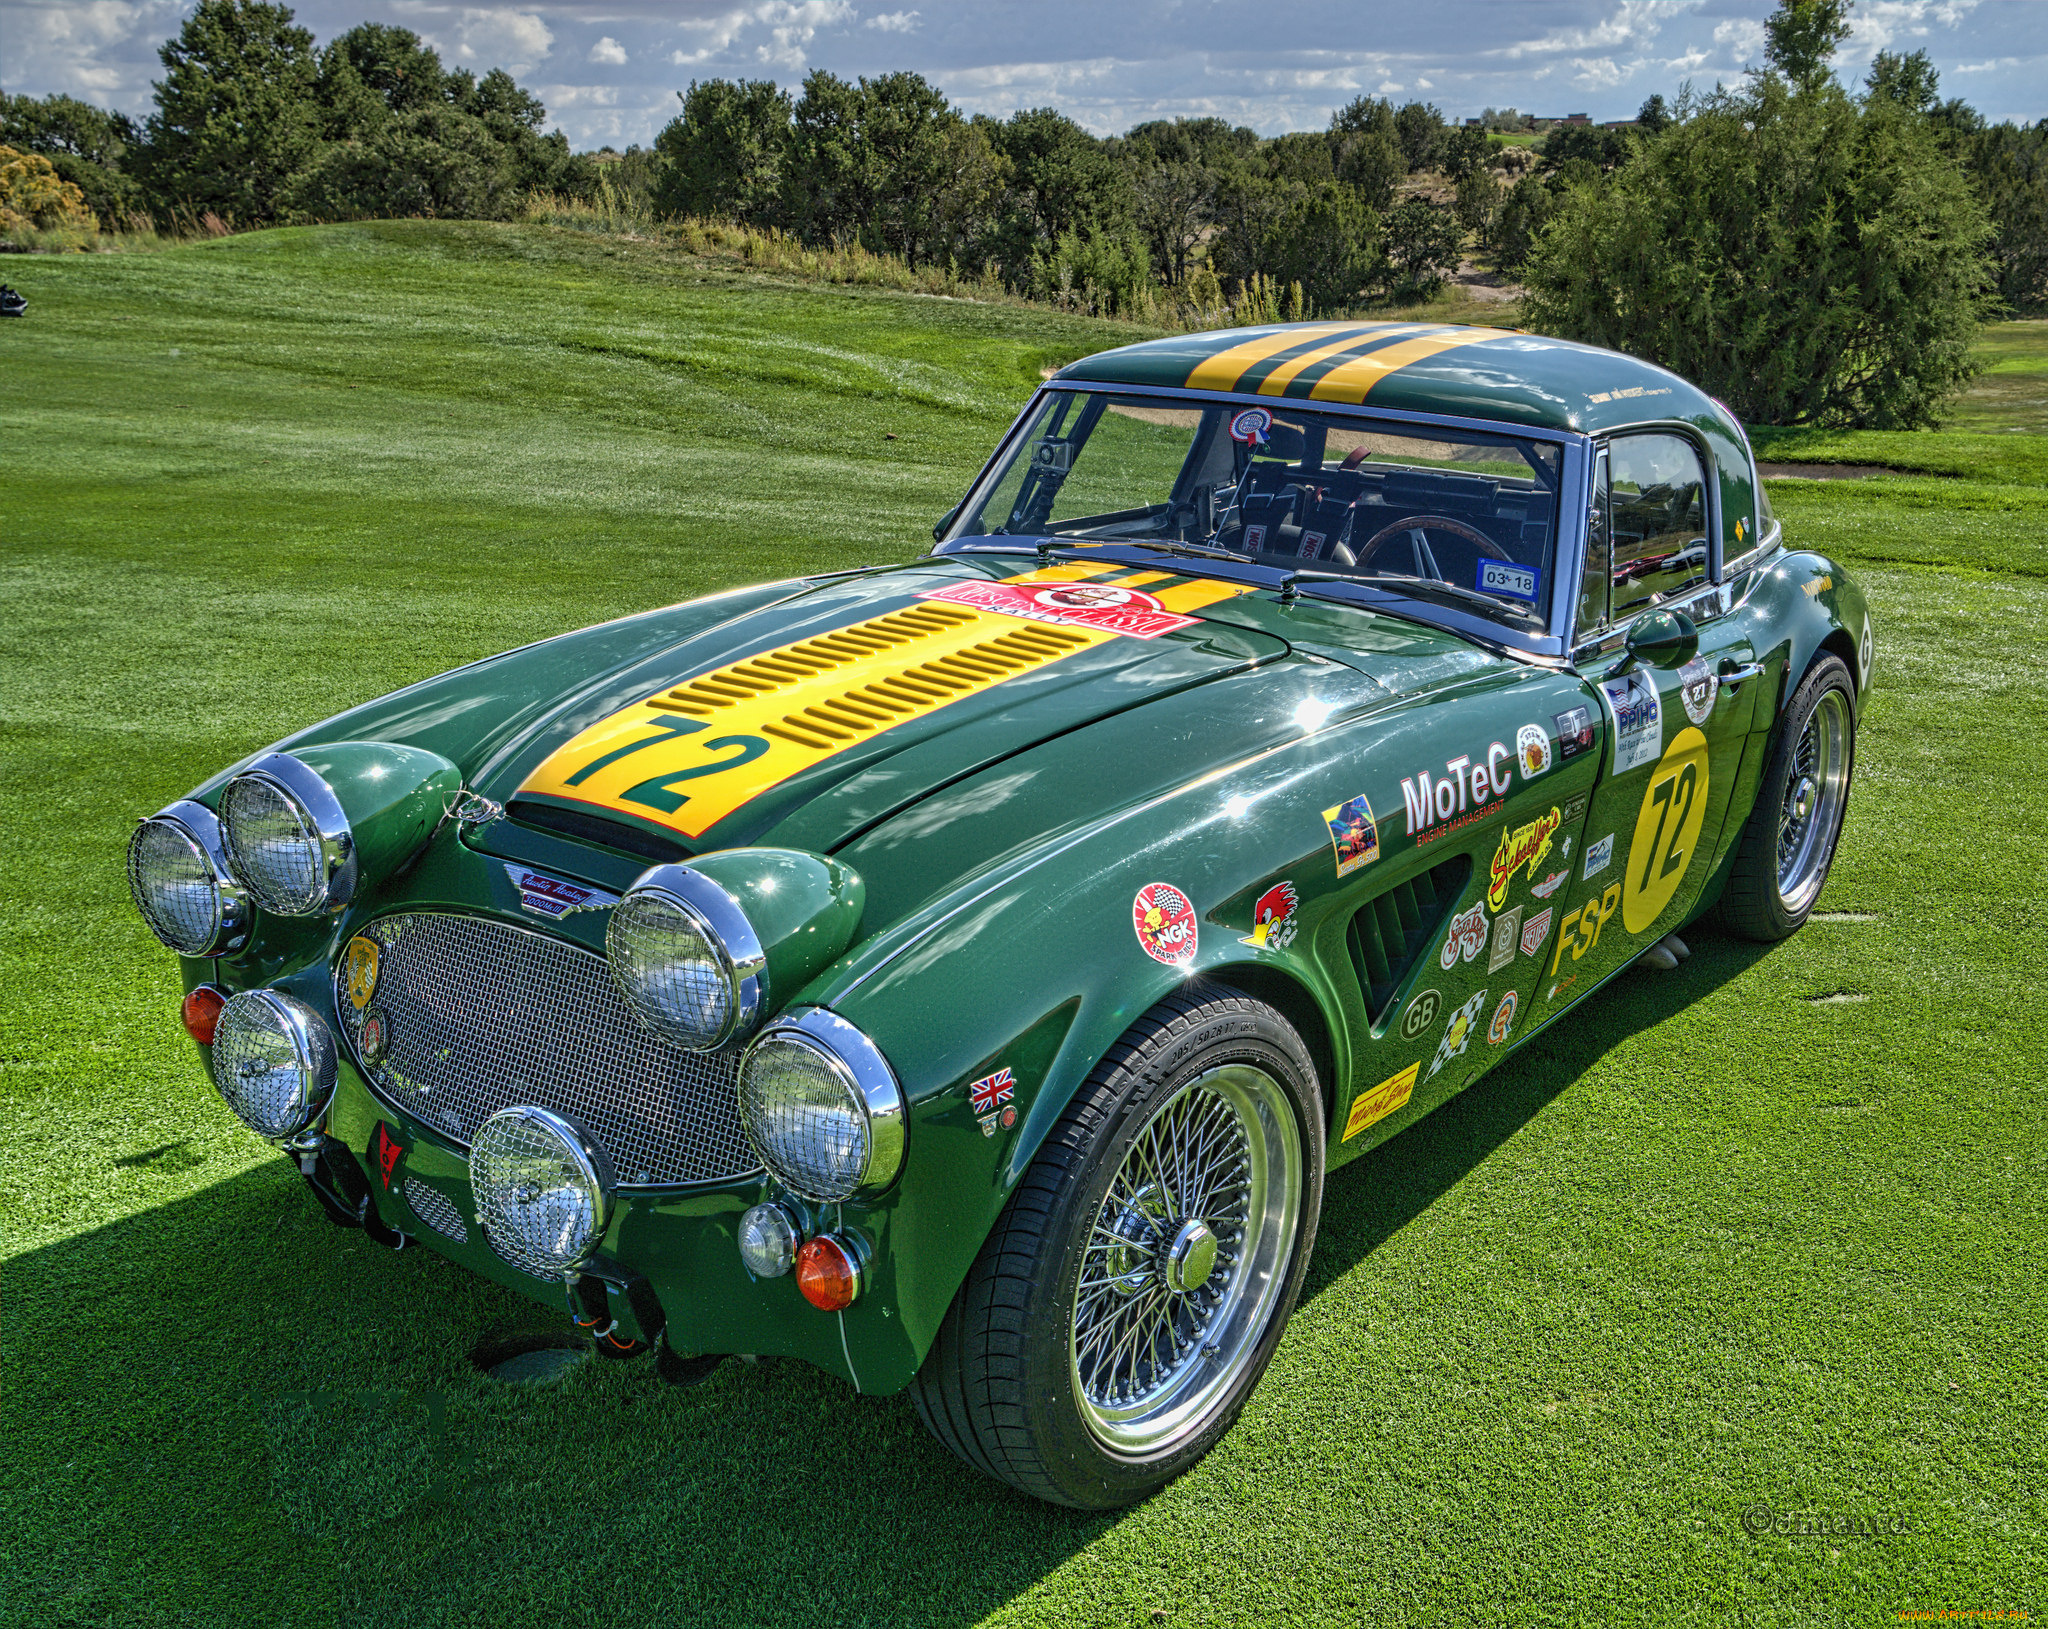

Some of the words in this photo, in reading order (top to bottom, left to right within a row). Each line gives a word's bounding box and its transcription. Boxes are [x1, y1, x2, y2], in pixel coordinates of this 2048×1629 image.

[1487, 572, 1505, 584] 03
[1515, 577, 1532, 590] 18
[946, 583, 1056, 615] CRESCENT
[1056, 607, 1183, 635] CLASSIC
[985, 605, 1068, 624] RALLY
[1693, 683, 1706, 701] 27
[1620, 702, 1658, 734] PPIHC
[563, 714, 771, 815] 72
[1400, 741, 1511, 837] MoTeC
[1417, 823, 1447, 848] ENGINE
[1449, 798, 1505, 833] MANAGEMENT
[1639, 763, 1697, 894] 72
[1366, 850, 1378, 864] 500
[522, 875, 551, 892] Austin
[553, 884, 587, 904] Healey
[1157, 918, 1193, 949] NGK
[1551, 883, 1622, 977] FSP
[1151, 944, 1177, 960] SPARK
[1407, 997, 1434, 1034] GB
